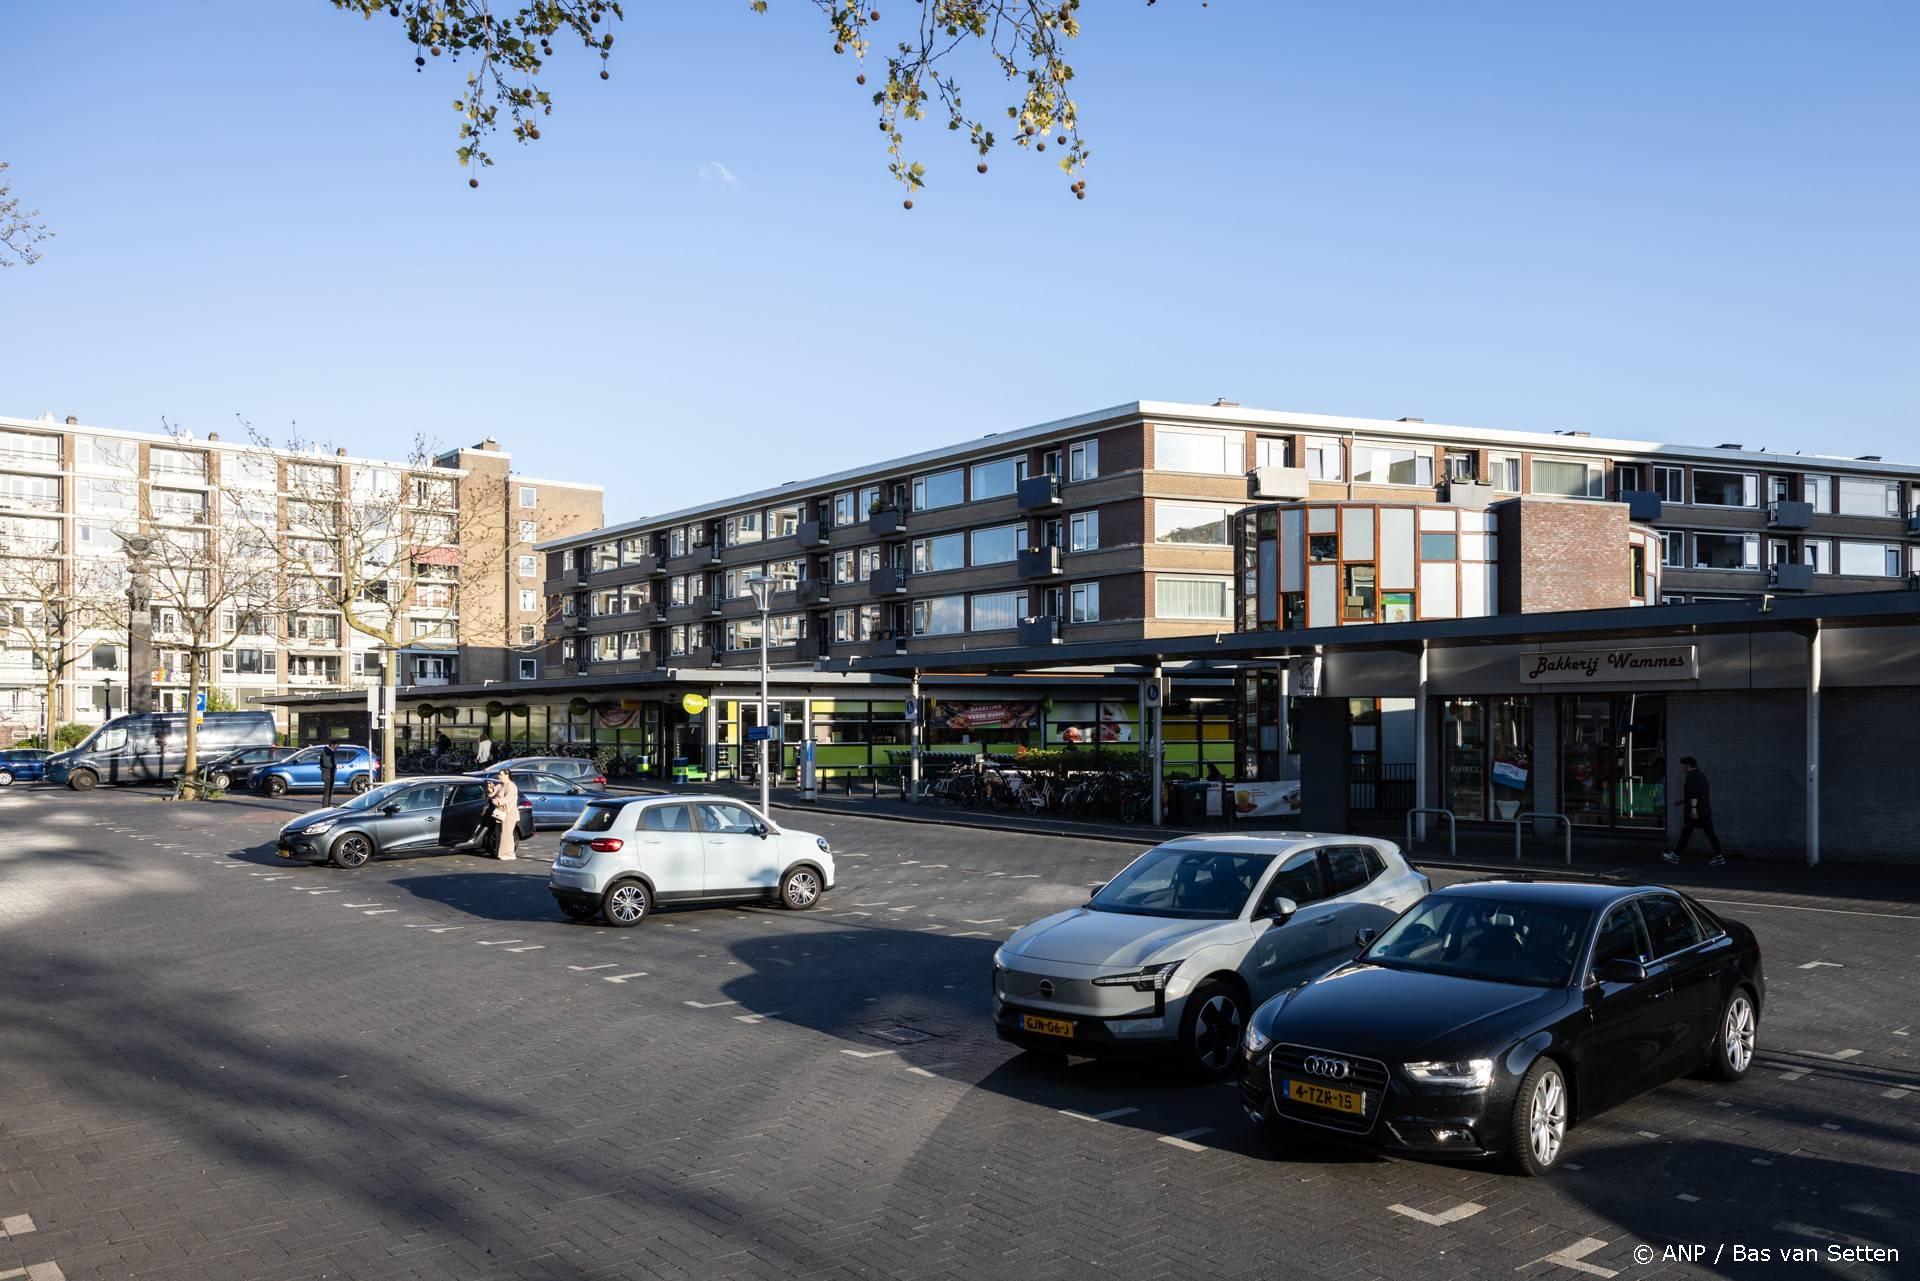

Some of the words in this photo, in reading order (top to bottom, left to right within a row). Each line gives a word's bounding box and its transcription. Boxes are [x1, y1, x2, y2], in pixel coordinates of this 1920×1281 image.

[1529, 656, 1600, 679] Bakkerij
[1608, 653, 1685, 669] Wammes
[1026, 1017, 1069, 1035] GJN-06-J
[1295, 1084, 1353, 1109] 4-TZR-15
